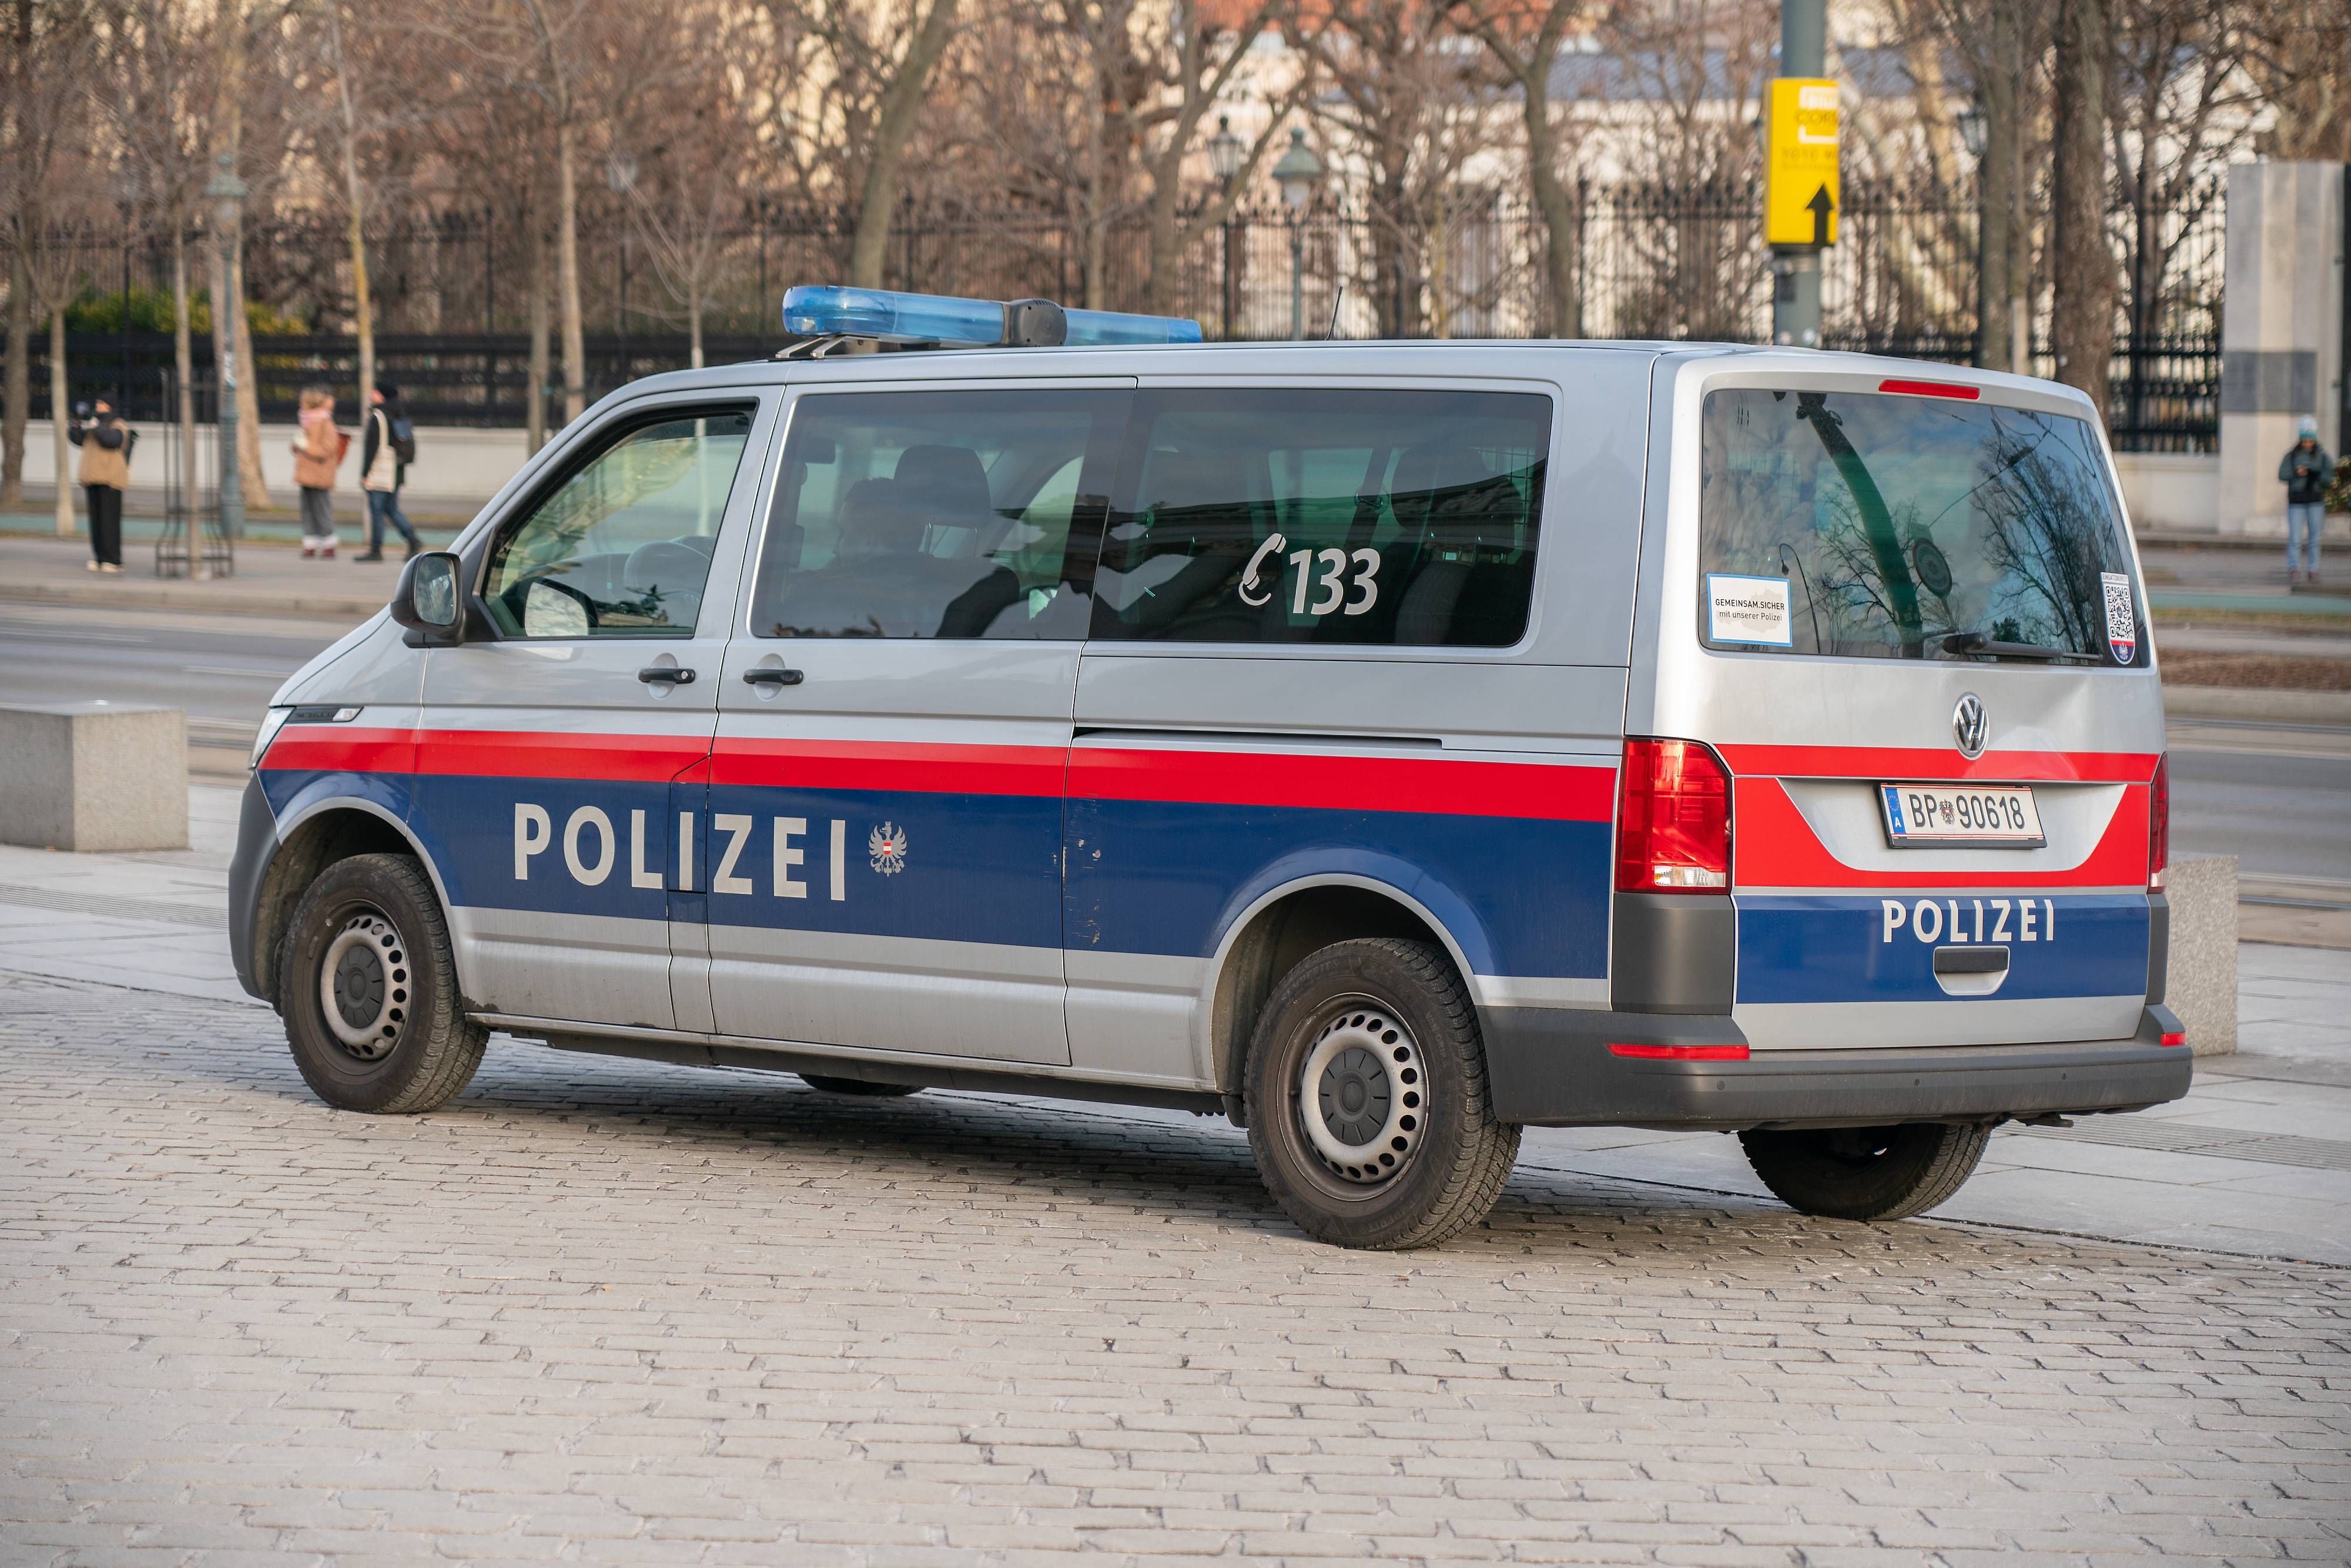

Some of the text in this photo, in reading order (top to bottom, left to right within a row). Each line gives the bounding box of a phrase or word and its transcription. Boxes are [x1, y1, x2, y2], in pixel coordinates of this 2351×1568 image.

[1290, 548, 1380, 615] 133
[1715, 598, 1784, 610] GEMEINSAM.SICHER
[1761, 612, 1782, 621] Polizei
[1894, 817, 1902, 827] A
[1909, 794, 2025, 829] BP 90618
[515, 802, 845, 902] POLIZEI
[1881, 899, 2054, 943] POLIZEI
